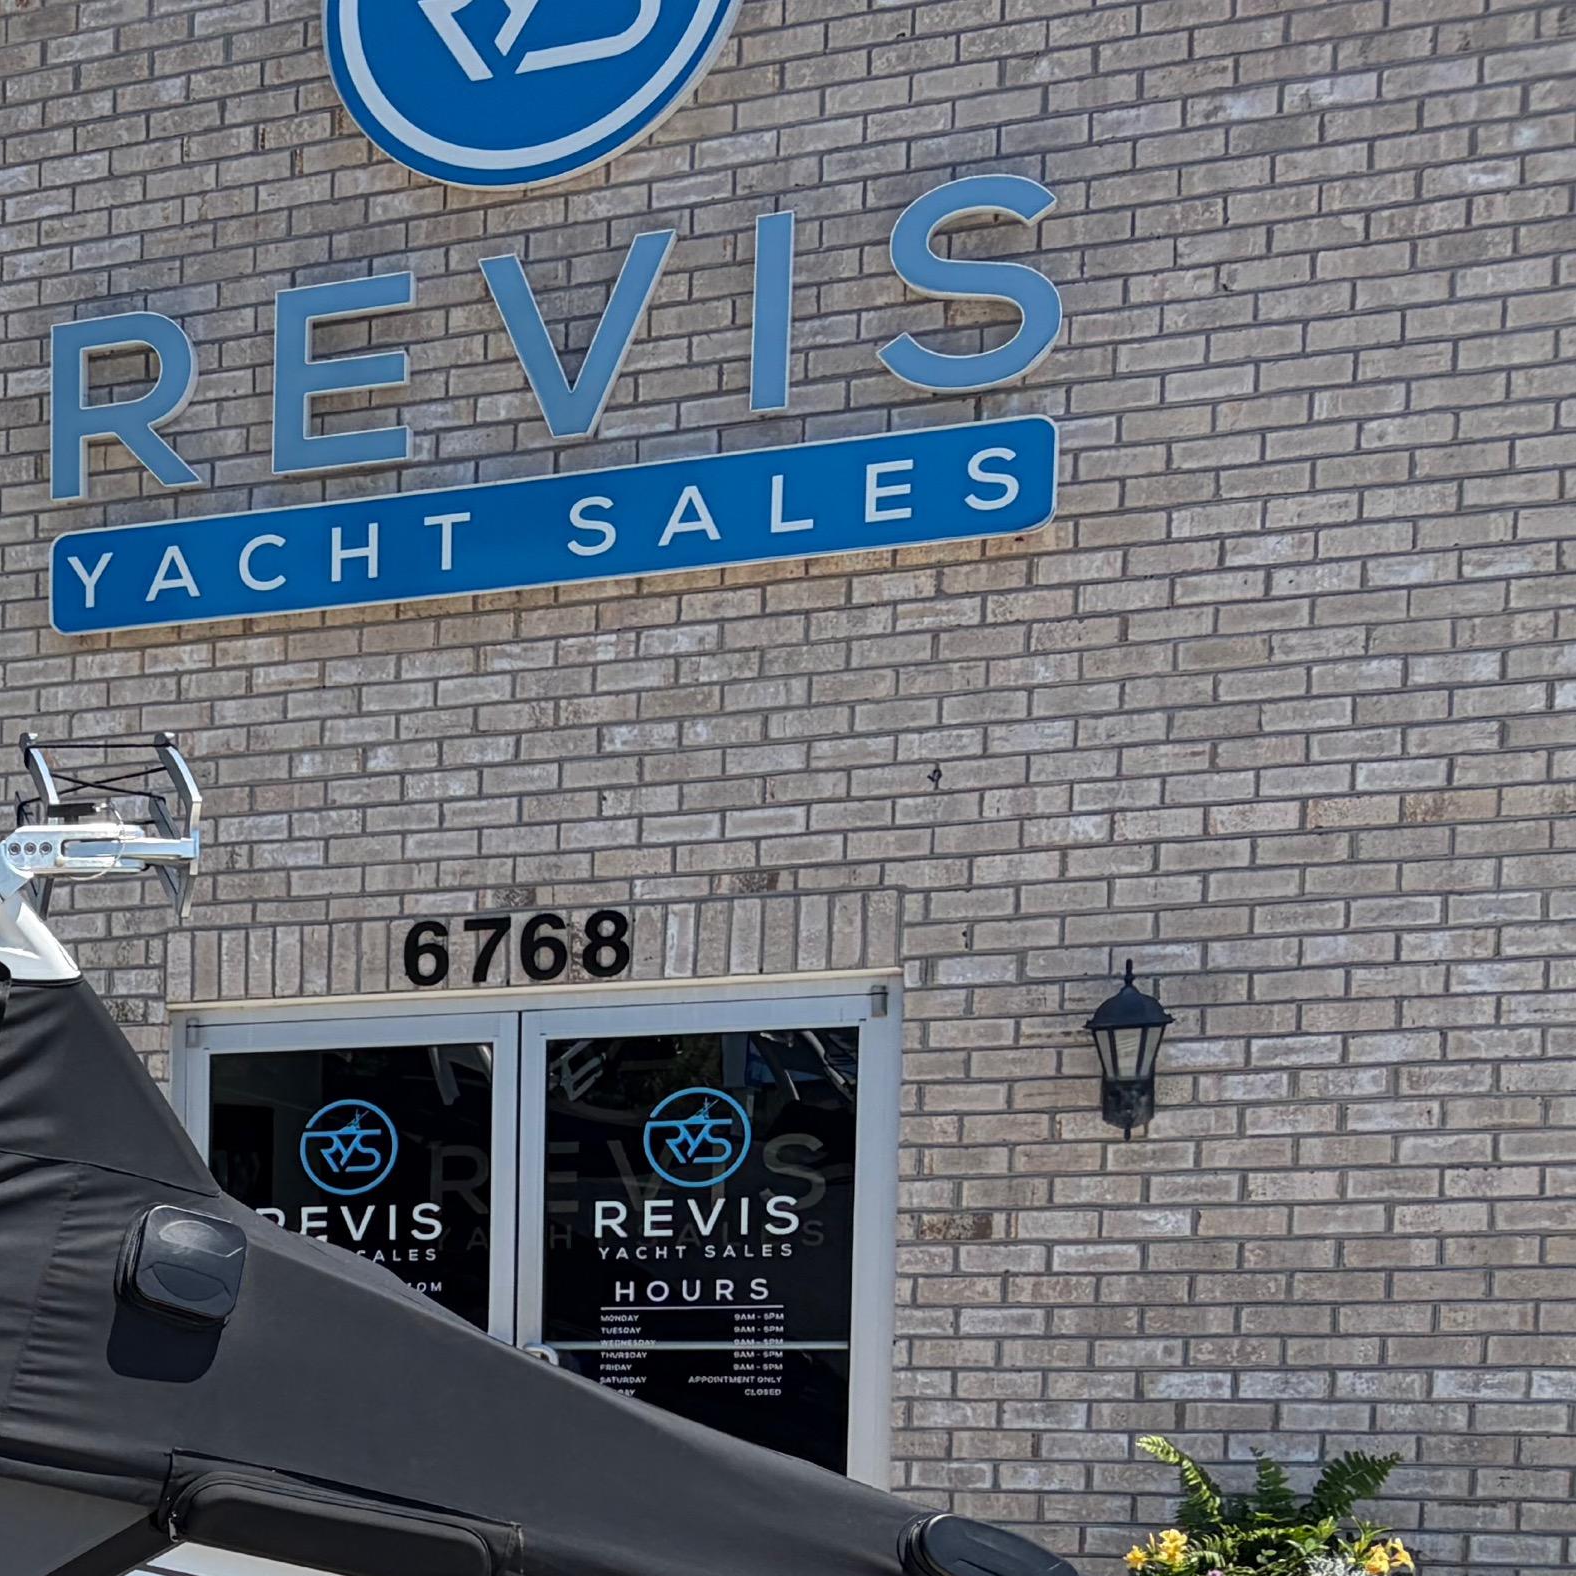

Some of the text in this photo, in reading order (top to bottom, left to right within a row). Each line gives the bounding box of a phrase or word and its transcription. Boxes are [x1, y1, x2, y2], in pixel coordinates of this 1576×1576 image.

[49, 173, 1063, 500] REVIS
[66, 446, 1021, 610] YACHT SALES
[403, 910, 631, 986] 6768
[594, 1195, 800, 1238] REVIS
[598, 1243, 793, 1260] YACHT SALES
[615, 1278, 769, 1302] HOURS
[600, 1314, 640, 1323] MONDAY
[600, 1327, 642, 1335] TUESDAY
[600, 1351, 648, 1360] THURSDAY
[600, 1363, 633, 1371] FRIDAY
[599, 1376, 648, 1384] SATURDAY
[688, 1375, 755, 1383] APPOINTMENT
[744, 1388, 782, 1396] CLOSED
